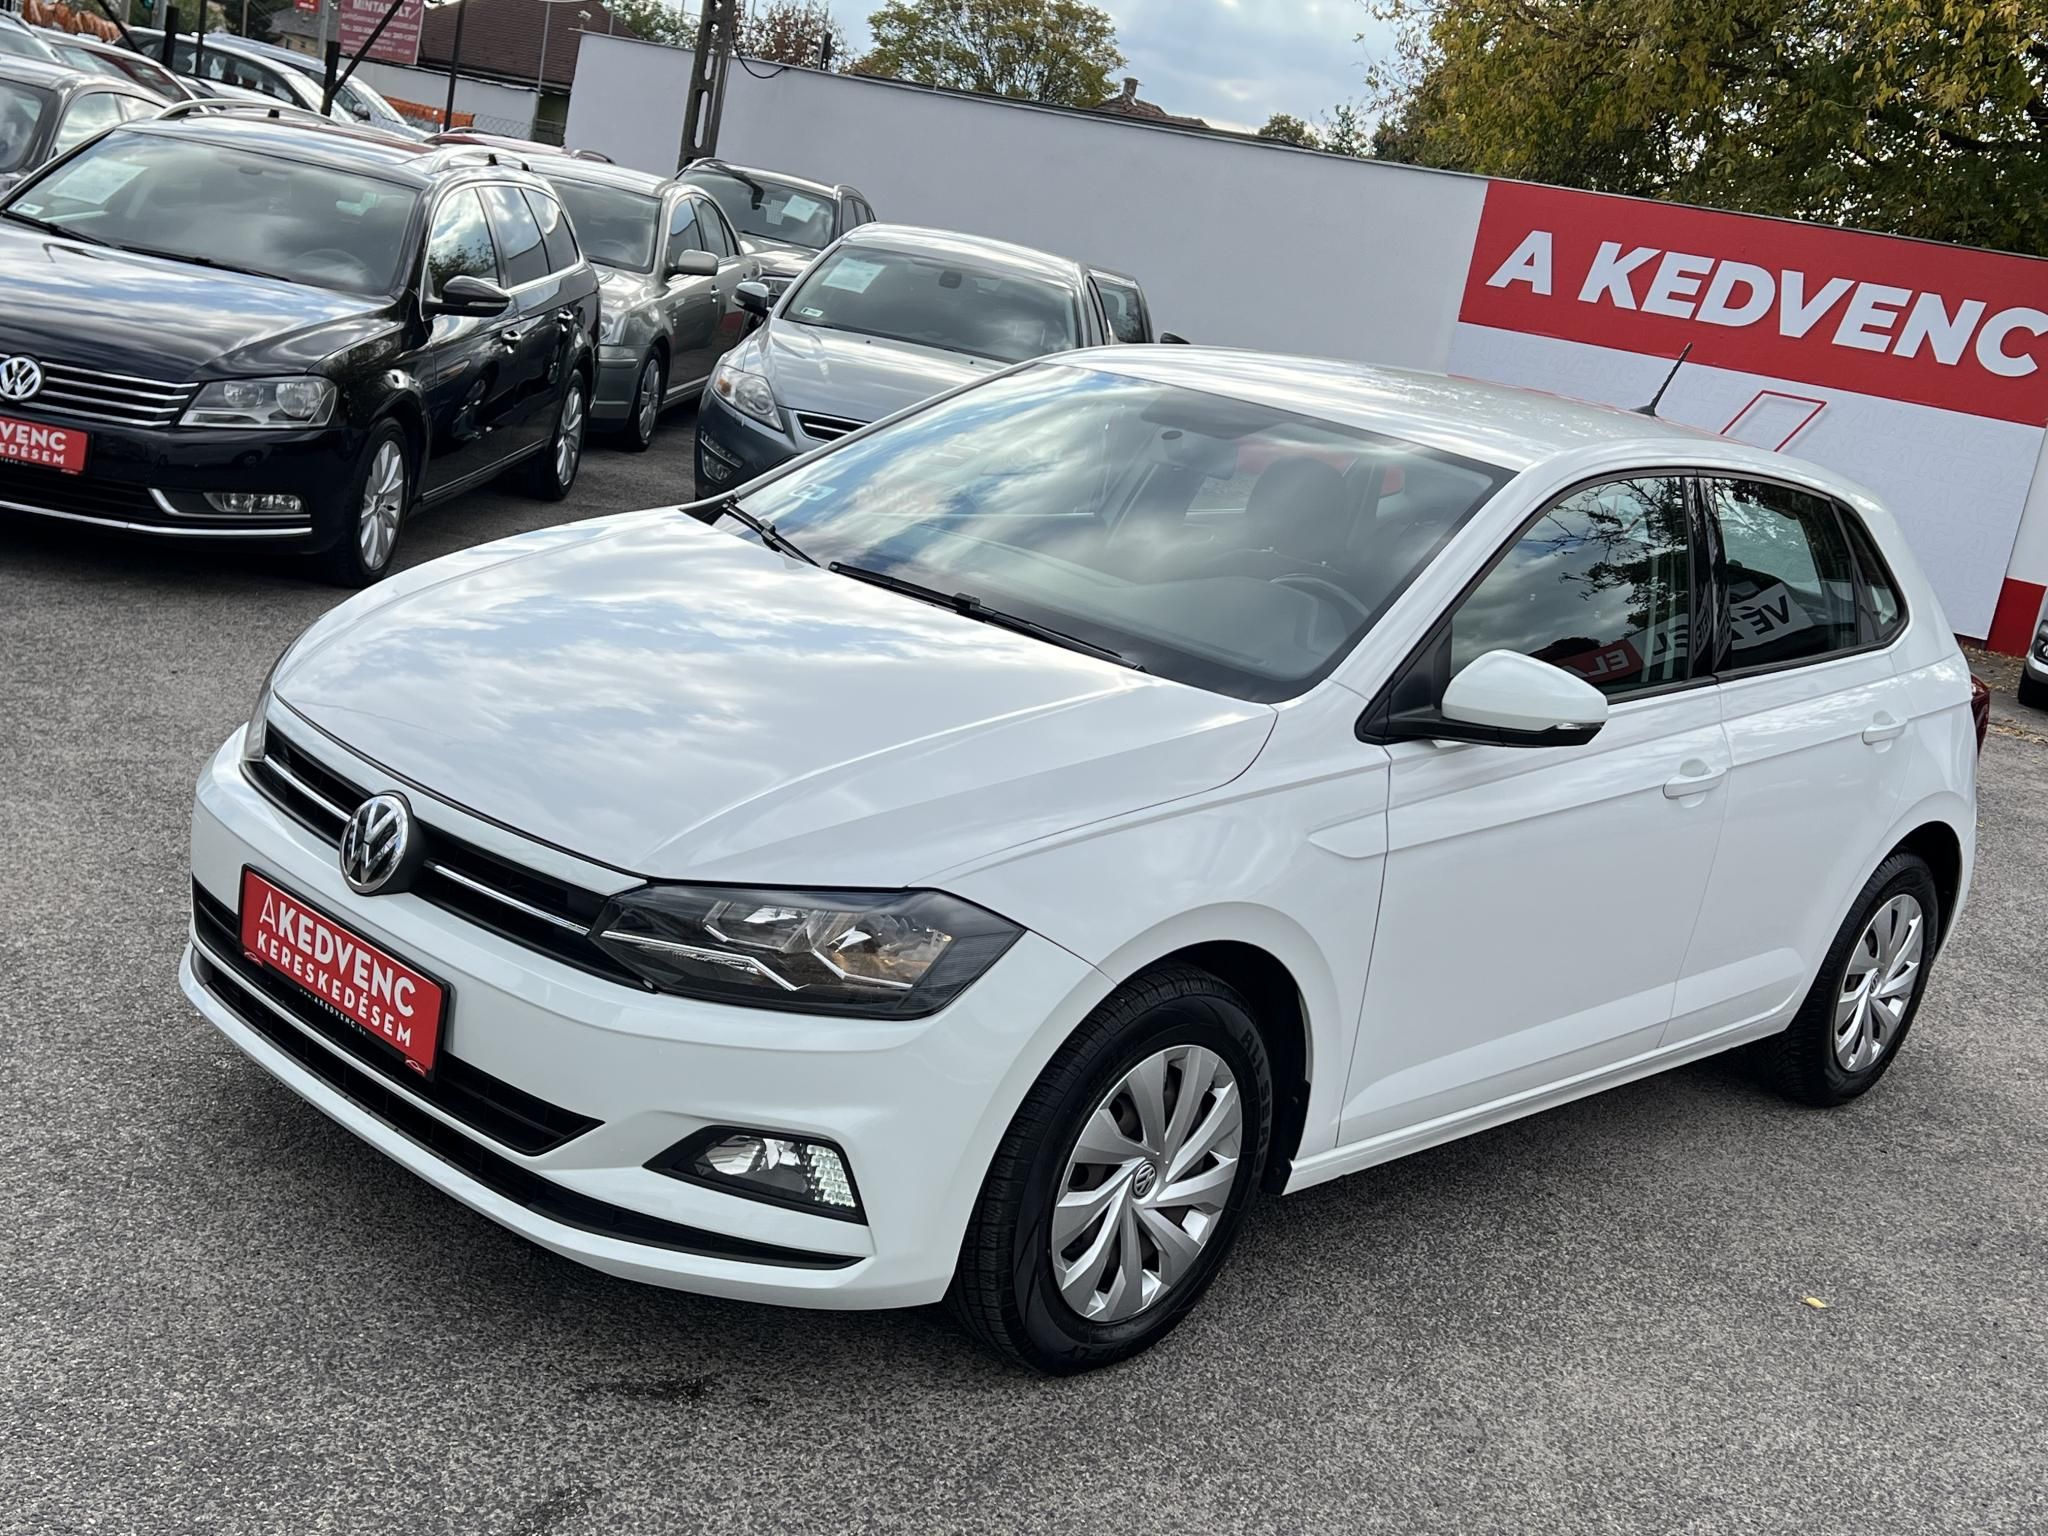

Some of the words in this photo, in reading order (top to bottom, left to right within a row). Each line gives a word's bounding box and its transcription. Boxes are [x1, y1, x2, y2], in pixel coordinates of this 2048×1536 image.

[1486, 230, 1552, 296] A
[1576, 240, 2048, 378] KEDVENC
[256, 930, 412, 1048] KERESKEDÉSEM
